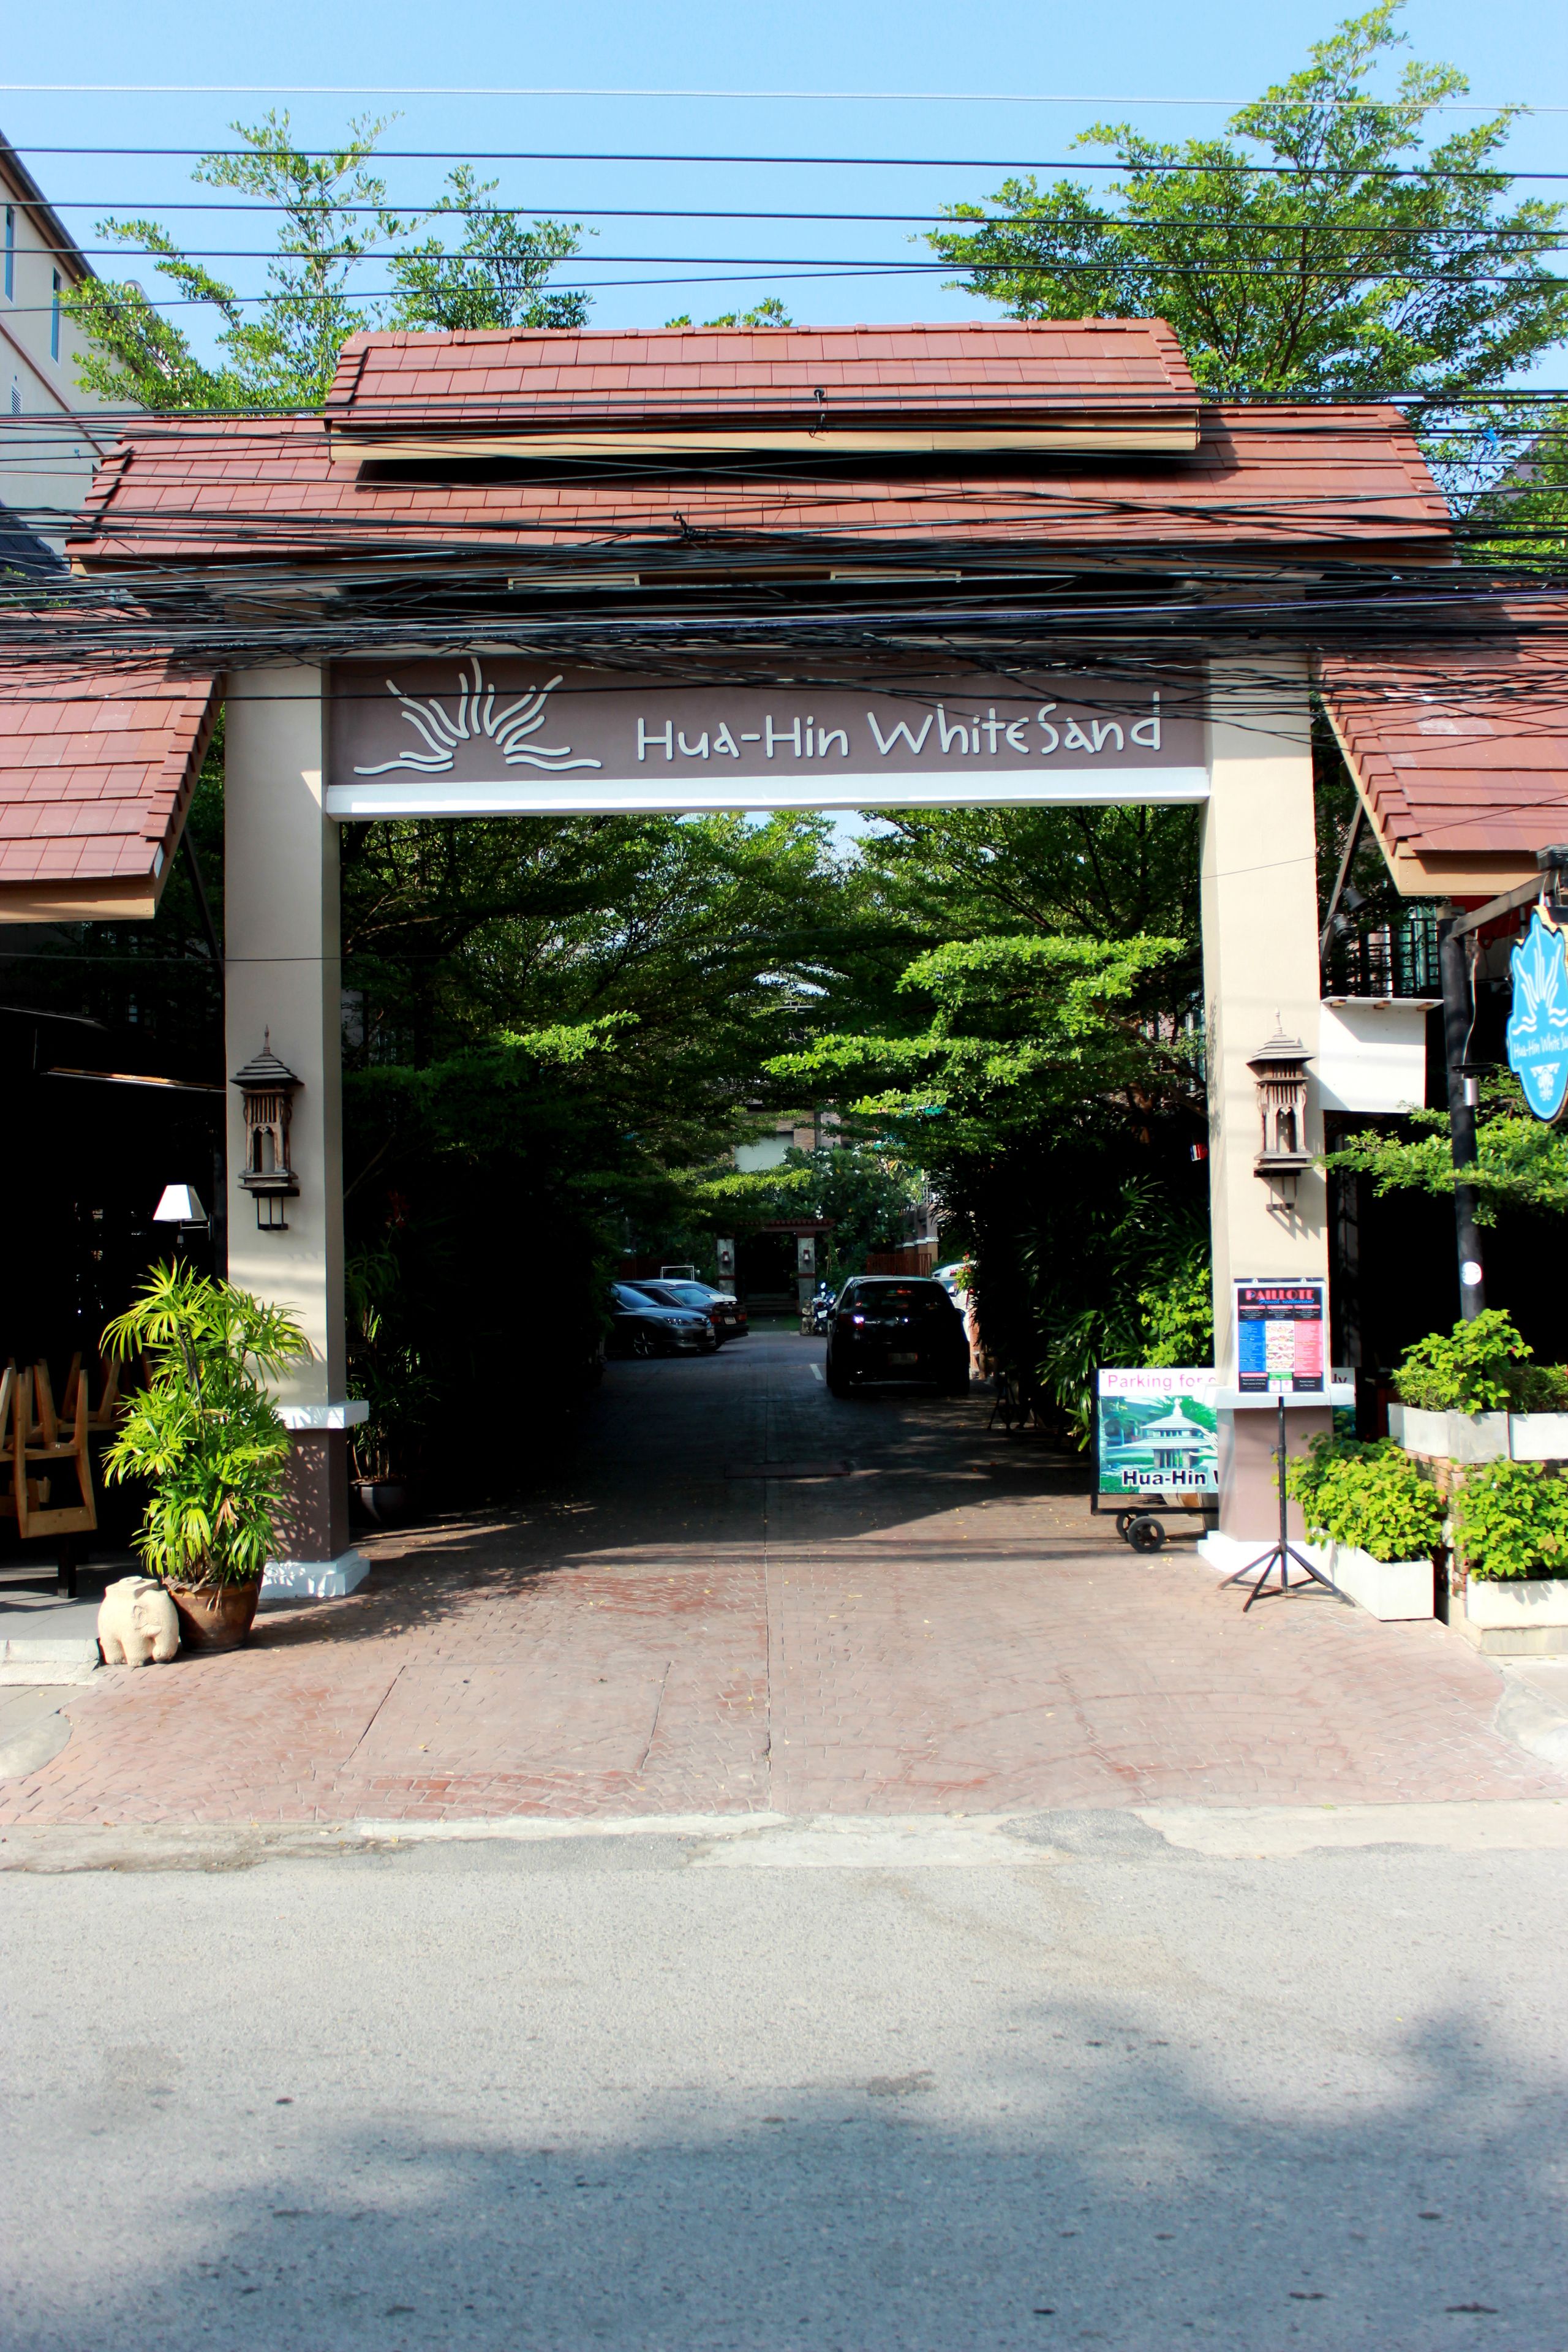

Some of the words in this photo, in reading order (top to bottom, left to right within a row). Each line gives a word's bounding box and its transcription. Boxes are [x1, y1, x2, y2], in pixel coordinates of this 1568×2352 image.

[638, 715, 849, 761] Hua-Hin
[1513, 1038, 1540, 1060] Hua-Hin
[1540, 1031, 1561, 1053] White
[1246, 1289, 1314, 1300] PAILLOTE
[1107, 1374, 1172, 1391] Parking
[1179, 1374, 1203, 1387] for
[1123, 1470, 1206, 1485] Hua-Hin
